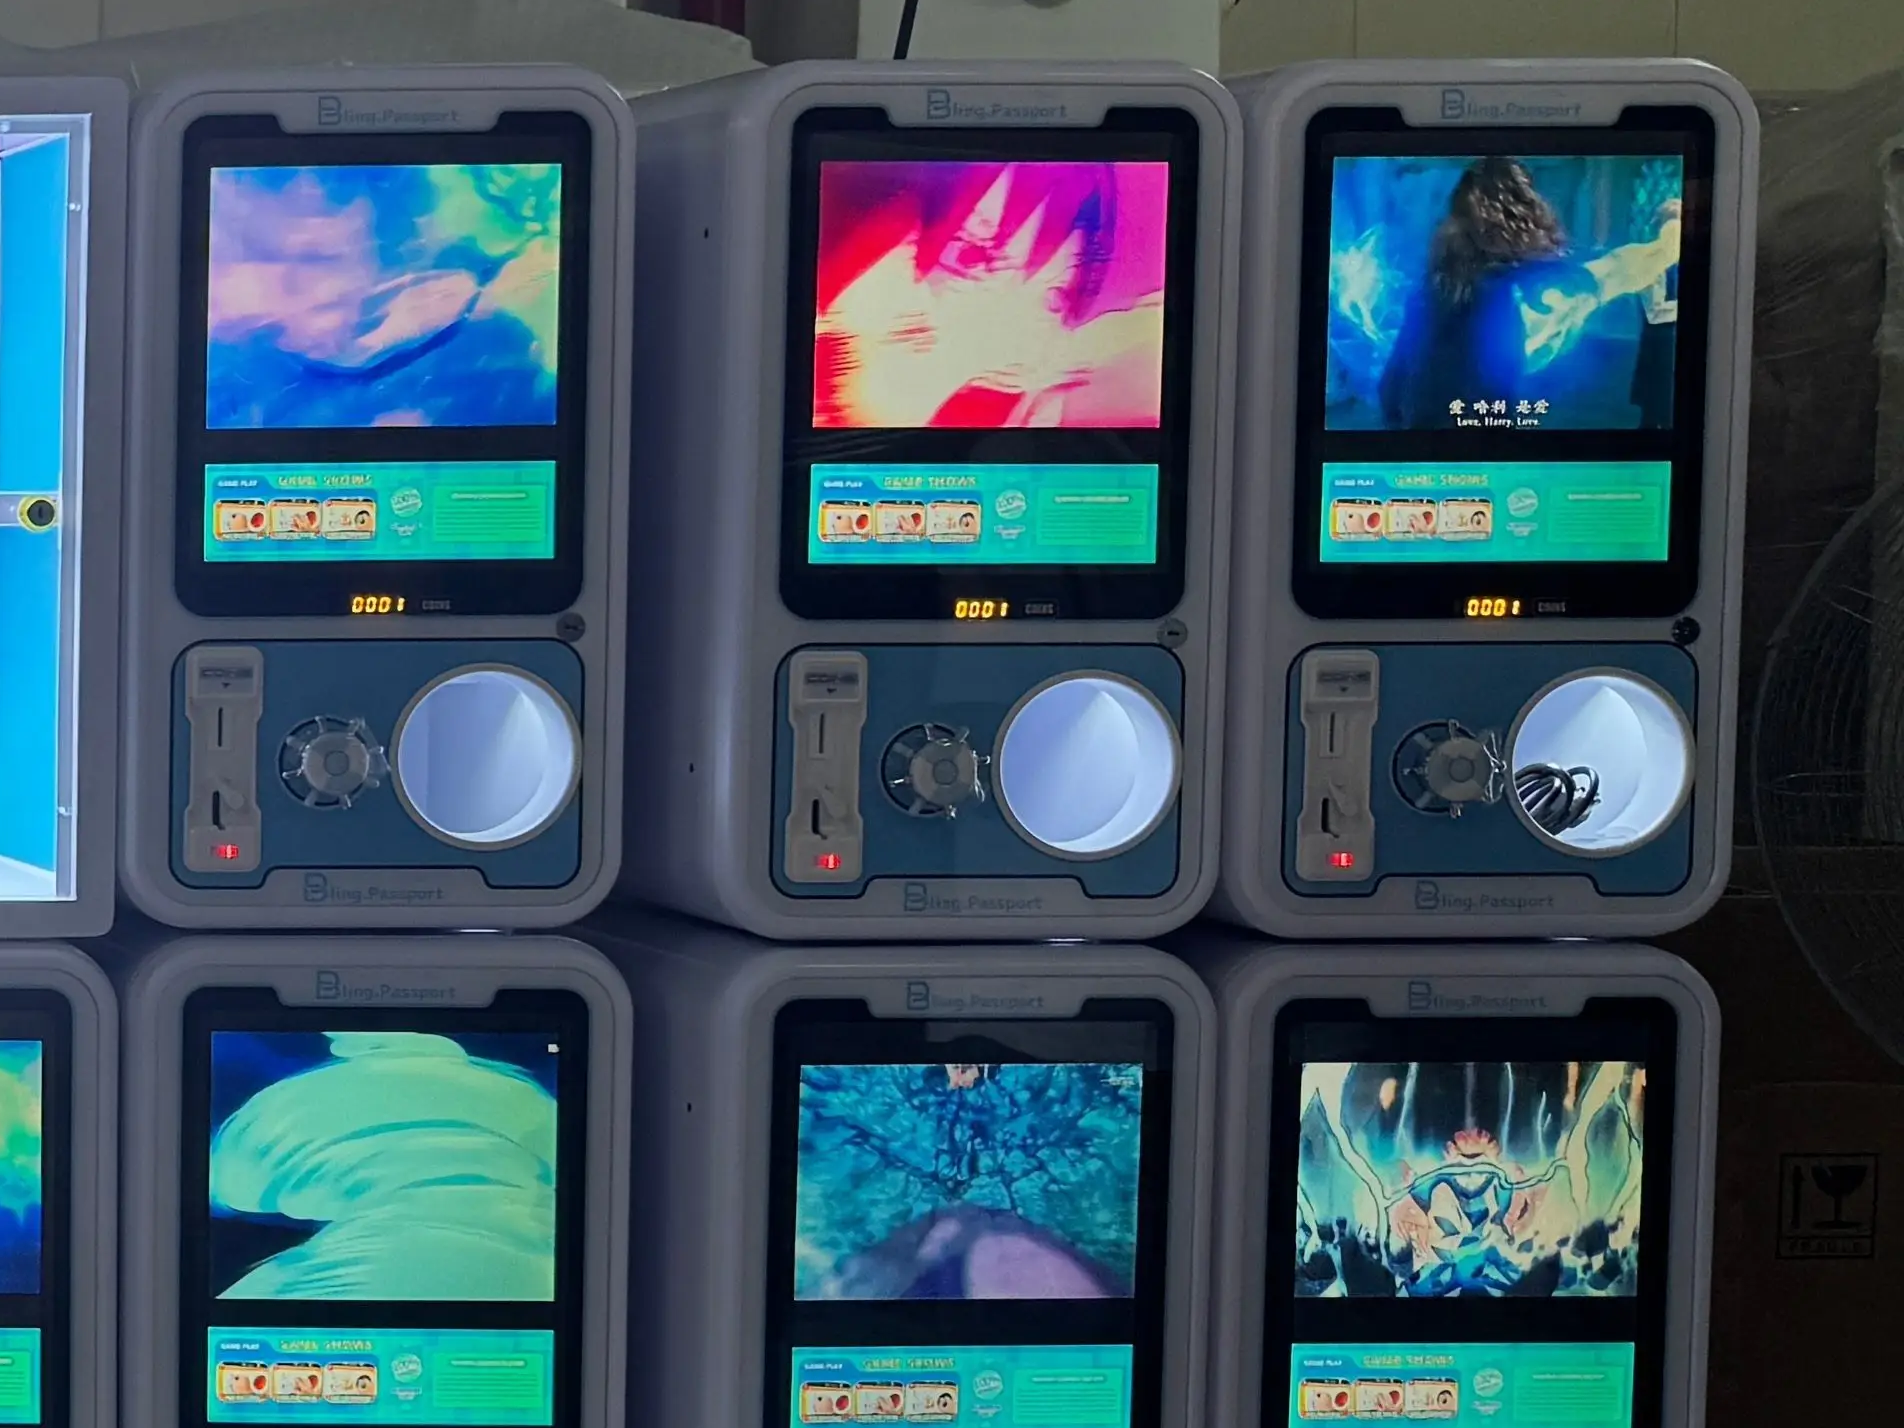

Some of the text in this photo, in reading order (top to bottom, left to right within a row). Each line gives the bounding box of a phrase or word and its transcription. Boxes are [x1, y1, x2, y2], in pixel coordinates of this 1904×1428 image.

[352, 596, 404, 613] 0001
[955, 601, 1007, 618] 0001
[1467, 599, 1519, 616] 0001
